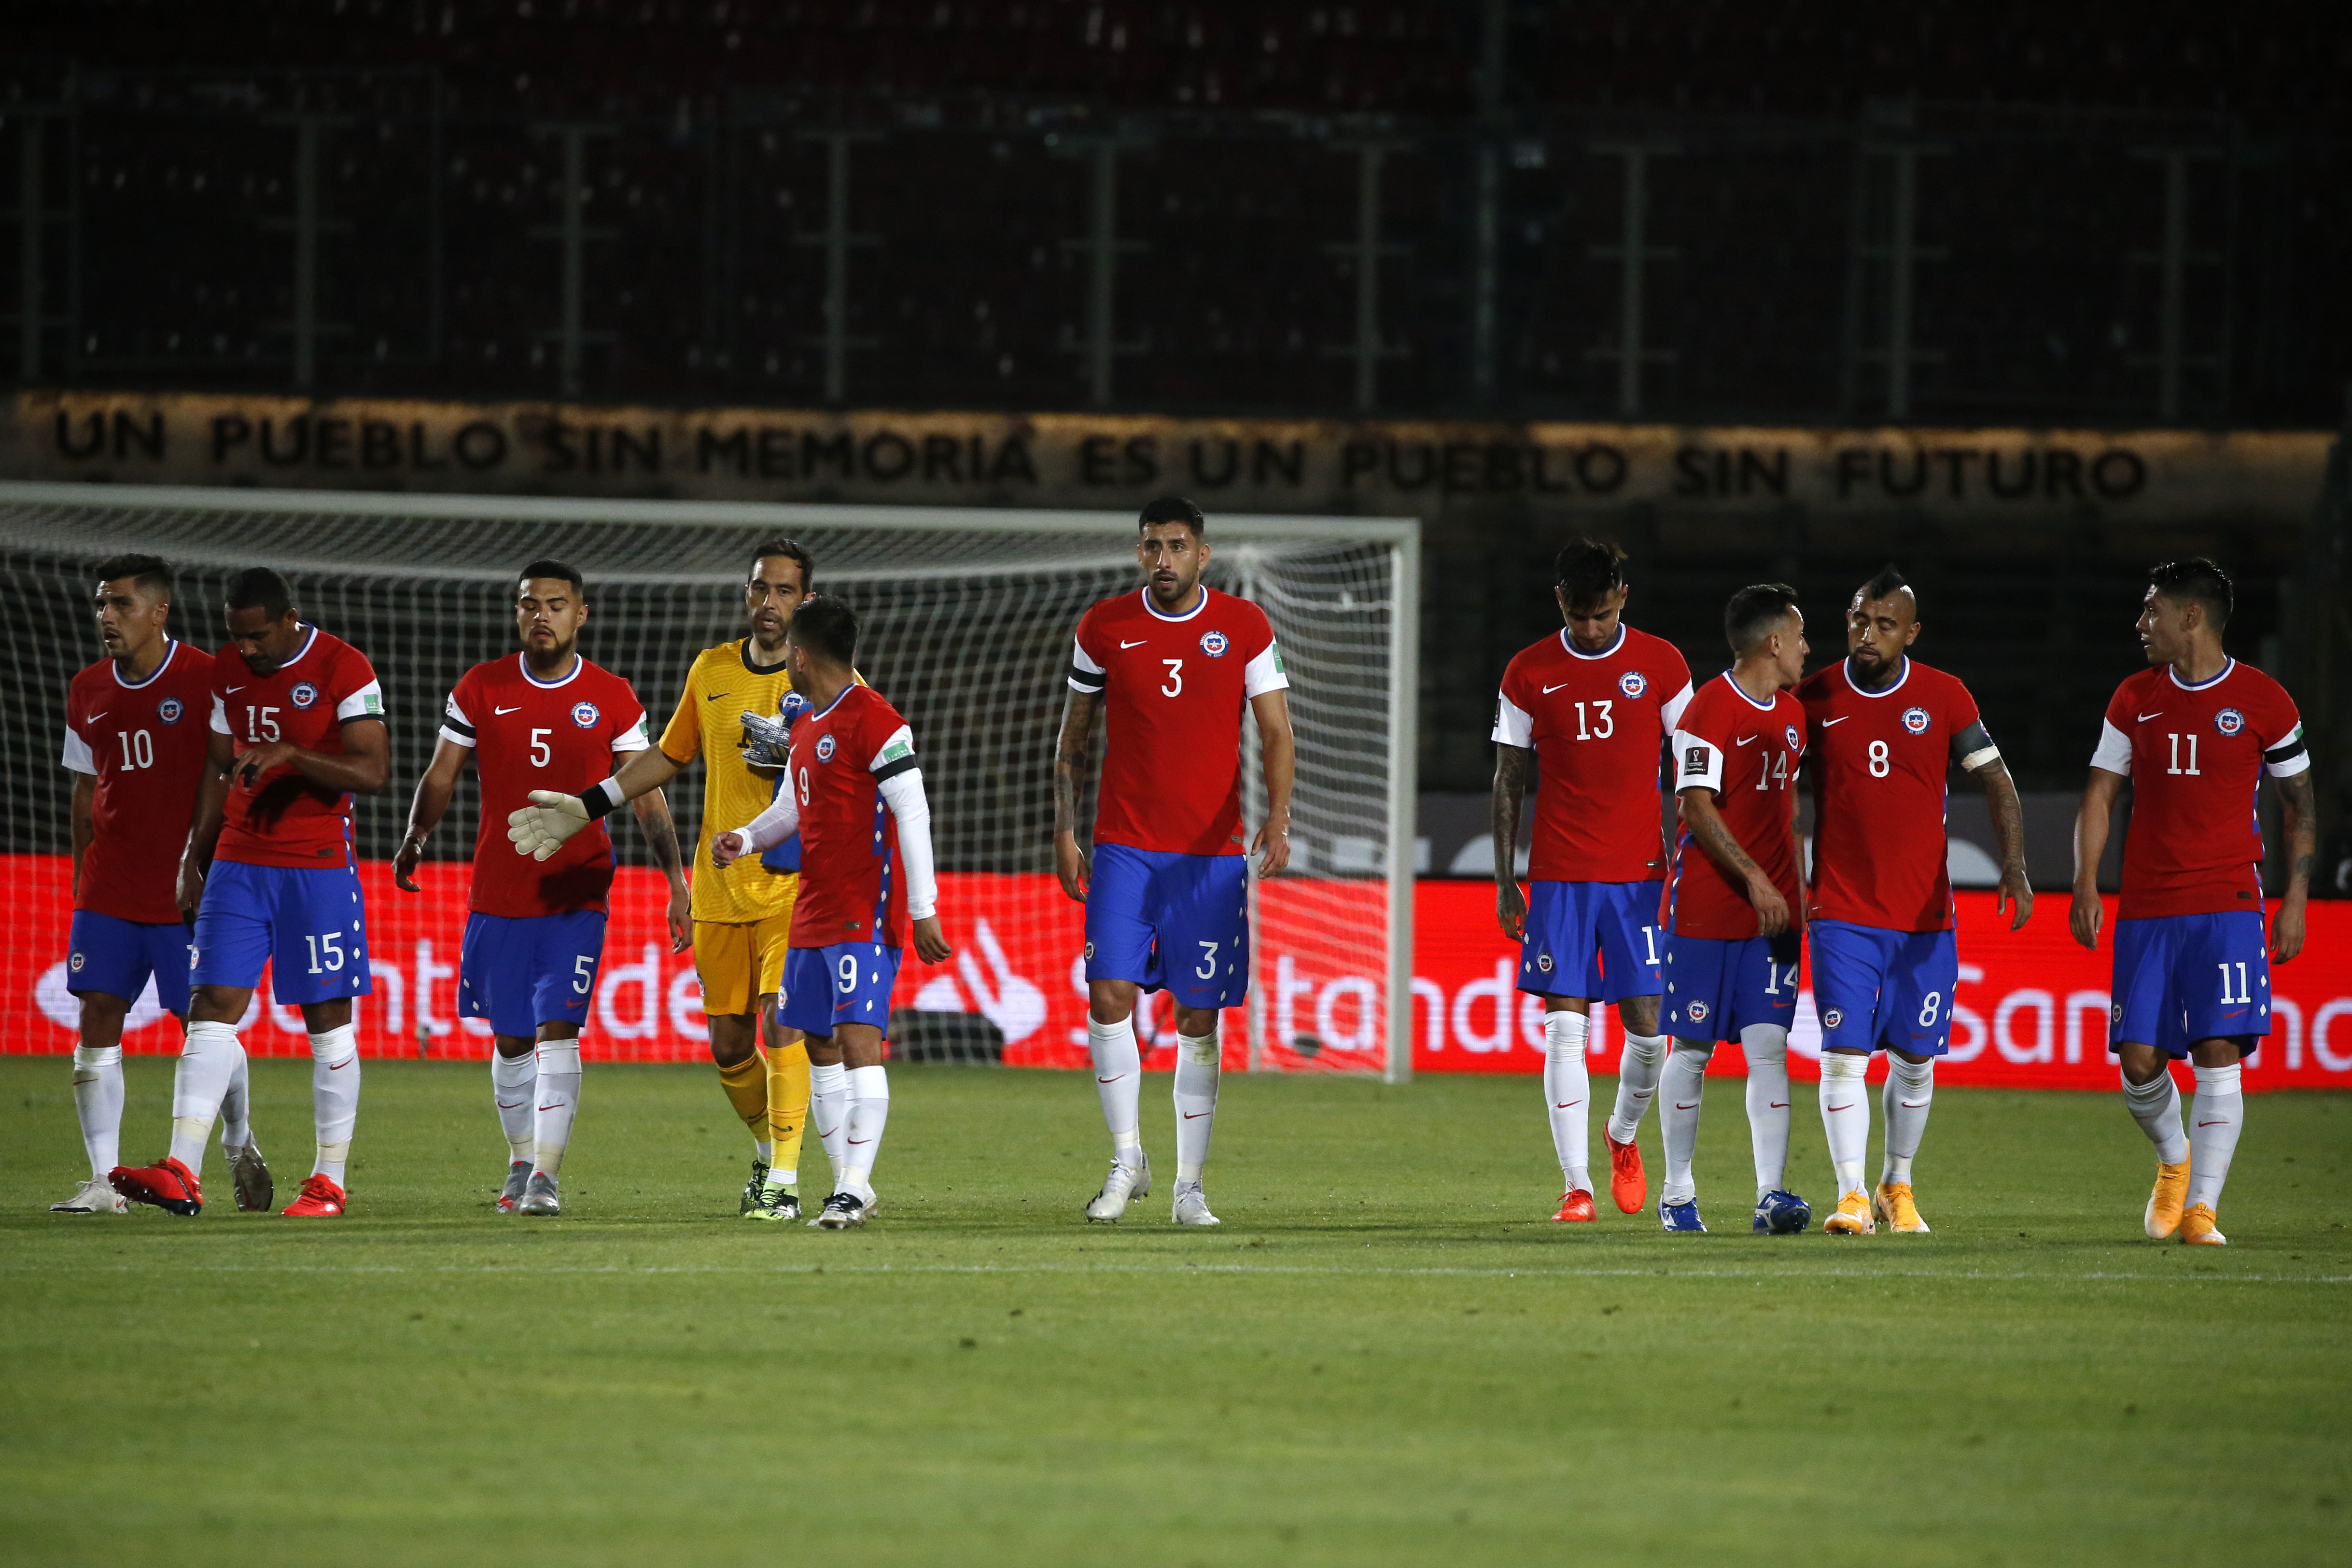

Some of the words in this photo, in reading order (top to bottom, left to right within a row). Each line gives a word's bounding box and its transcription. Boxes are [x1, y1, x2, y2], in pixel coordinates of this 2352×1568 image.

[54, 410, 166, 462] UN
[210, 415, 509, 470] PUEBLO
[539, 422, 662, 475] SIN
[695, 426, 1039, 483] MEMORIA
[1079, 434, 1159, 484] ES
[1187, 438, 1307, 489] UN
[1343, 442, 1629, 494] PUEBLO
[1673, 447, 1790, 498] SIN
[1837, 450, 2147, 501] FUTURO
[1162, 659, 1183, 698] 3
[246, 706, 280, 742] 15
[1575, 700, 1614, 741] 13
[118, 729, 153, 771] 10
[530, 728, 552, 767] 5
[1868, 740, 1890, 777] 8
[2167, 733, 2200, 775] 11
[799, 767, 810, 806] 9
[1756, 750, 1787, 790] 14
[305, 932, 344, 974] 15
[1196, 941, 1218, 980] 3
[1642, 925, 1662, 965] 1
[573, 955, 594, 994] 5
[838, 954, 857, 994] 9
[1765, 957, 1798, 999] 14
[2218, 962, 2251, 1004] 11
[1918, 992, 1941, 1027] 8
